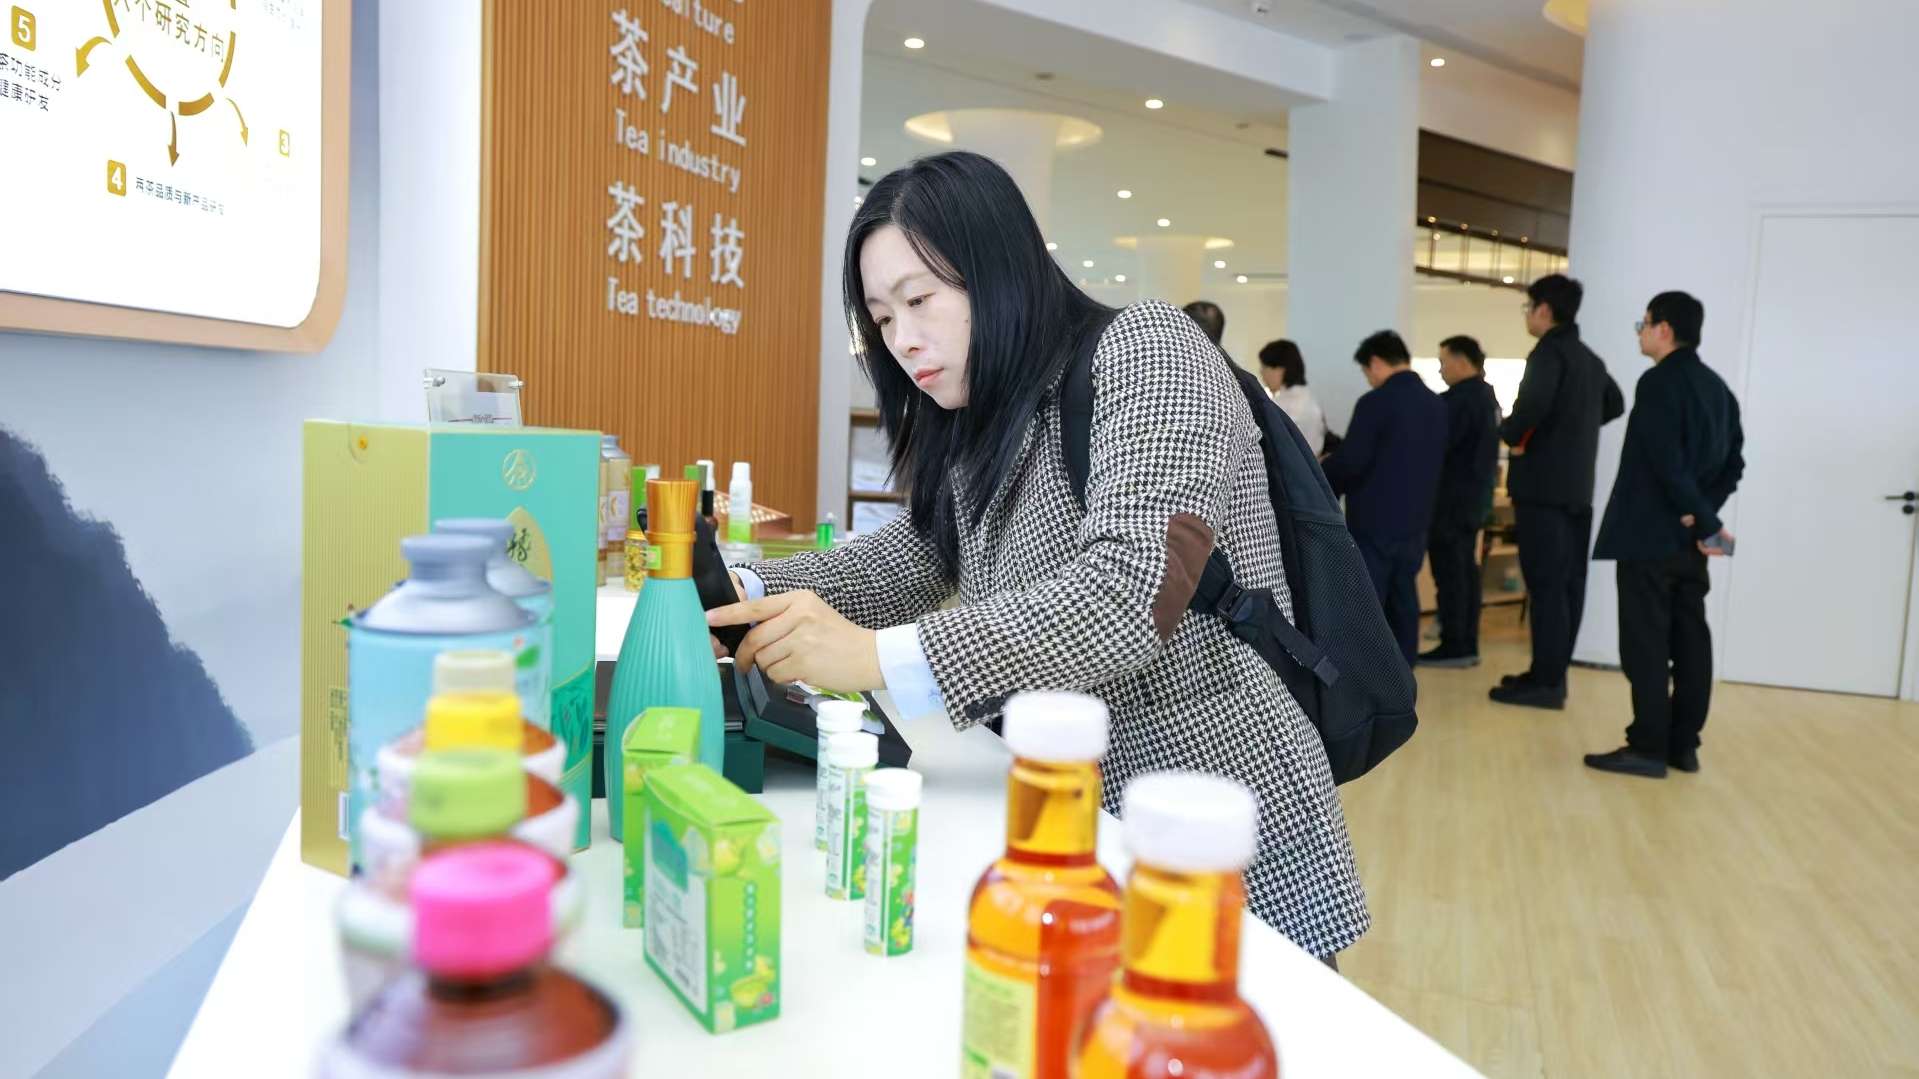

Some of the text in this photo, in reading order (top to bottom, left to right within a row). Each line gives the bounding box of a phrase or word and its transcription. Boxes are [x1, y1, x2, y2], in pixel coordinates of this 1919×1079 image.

[17, 14, 32, 43] 5
[609, 9, 747, 146] 茶产业
[111, 168, 124, 191] 4
[615, 107, 741, 194] Tea industry
[607, 180, 745, 289] 茶科技
[607, 276, 741, 335] Tea technology
